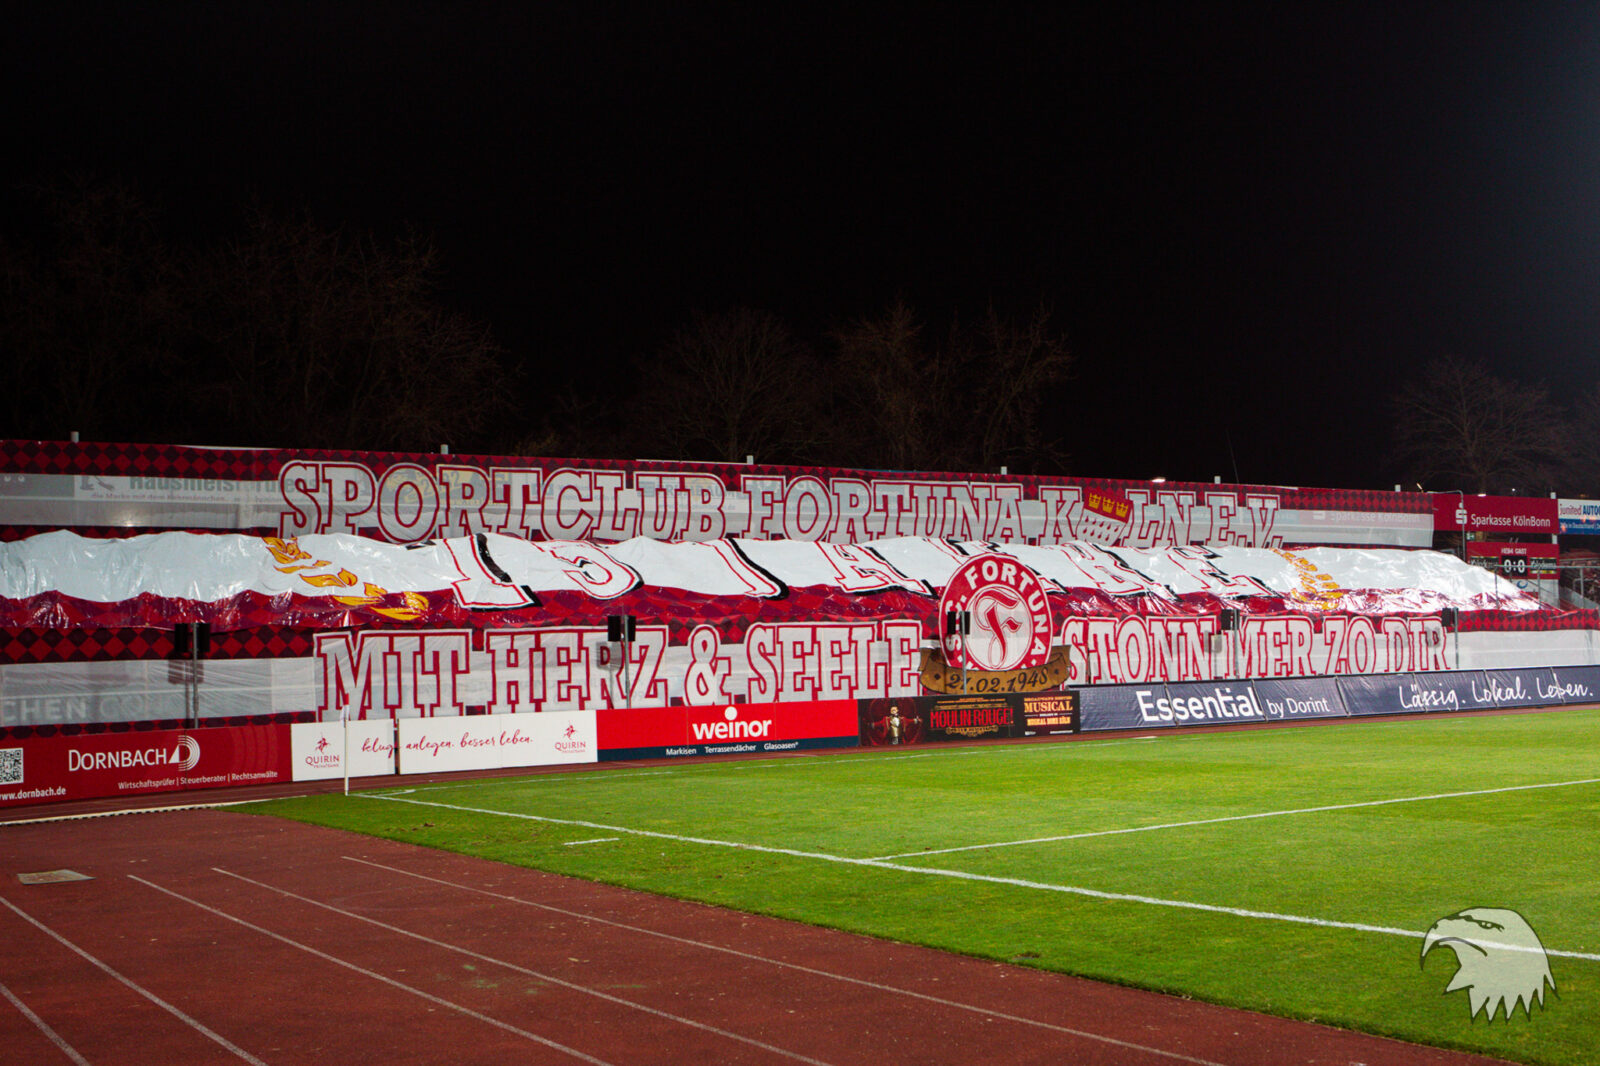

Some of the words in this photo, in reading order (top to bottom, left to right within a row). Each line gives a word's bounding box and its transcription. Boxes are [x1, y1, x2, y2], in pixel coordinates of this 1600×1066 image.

[279, 460, 727, 543] SPORTCLUB
[741, 475, 1026, 545] FORTUNA
[1038, 484, 1197, 548] KLN
[1582, 504, 1600, 516] AUTO
[1471, 513, 1512, 528] Sparkasse
[1512, 514, 1551, 527] KölnBonn
[965, 560, 1049, 656] FORTUNA
[1060, 614, 1217, 690] STONN
[1323, 614, 1377, 675] ZO
[1383, 615, 1451, 672] DIR
[314, 628, 473, 723] MIT
[484, 624, 668, 715] HERZ
[683, 624, 732, 707] &
[746, 619, 922, 703] SEELE
[1399, 683, 1466, 711] Lässig.
[1471, 676, 1532, 703] Lokal.
[1536, 672, 1594, 699] Leben.
[1024, 700, 1073, 714] MUSICAL
[1136, 686, 1263, 723] Essential
[1267, 698, 1284, 719] by
[1289, 696, 1331, 715] Dorint
[692, 706, 772, 740] weinor
[930, 710, 971, 729] MOULIN
[973, 708, 1014, 726] ROUGE!
[406, 735, 455, 757] anlegen.
[460, 731, 496, 748] besser
[499, 728, 534, 746] leben.
[554, 741, 587, 753] QUIRIN
[666, 748, 697, 756] Markisen
[704, 744, 757, 754] Terrassendächer
[68, 748, 168, 772] DORNBACH
[305, 755, 340, 766] QUIRIN
[118, 777, 175, 790] Wirtschaftsprüfer
[180, 774, 226, 786] Steuerberater
[231, 770, 278, 781] Rechtsanwälte
